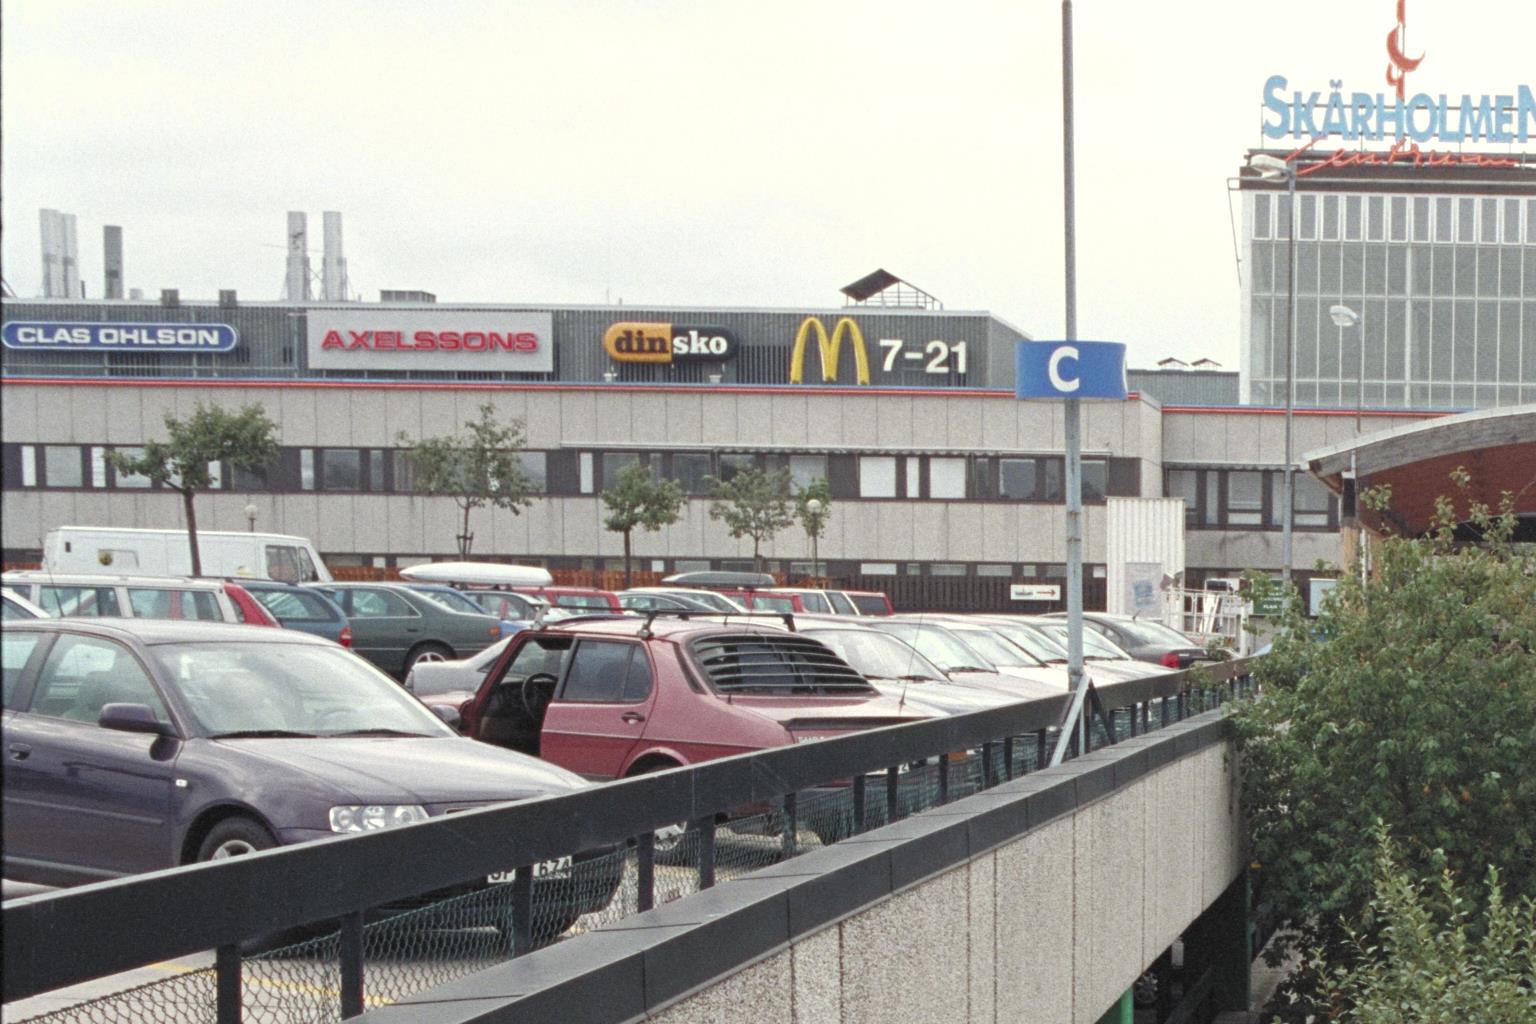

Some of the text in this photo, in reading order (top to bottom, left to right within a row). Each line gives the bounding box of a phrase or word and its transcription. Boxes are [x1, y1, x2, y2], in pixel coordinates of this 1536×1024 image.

[17, 327, 219, 345] CLAS OHLSON
[321, 330, 539, 352] AXELSSONS
[879, 338, 968, 374] 7-21
[1047, 345, 1081, 393] C
